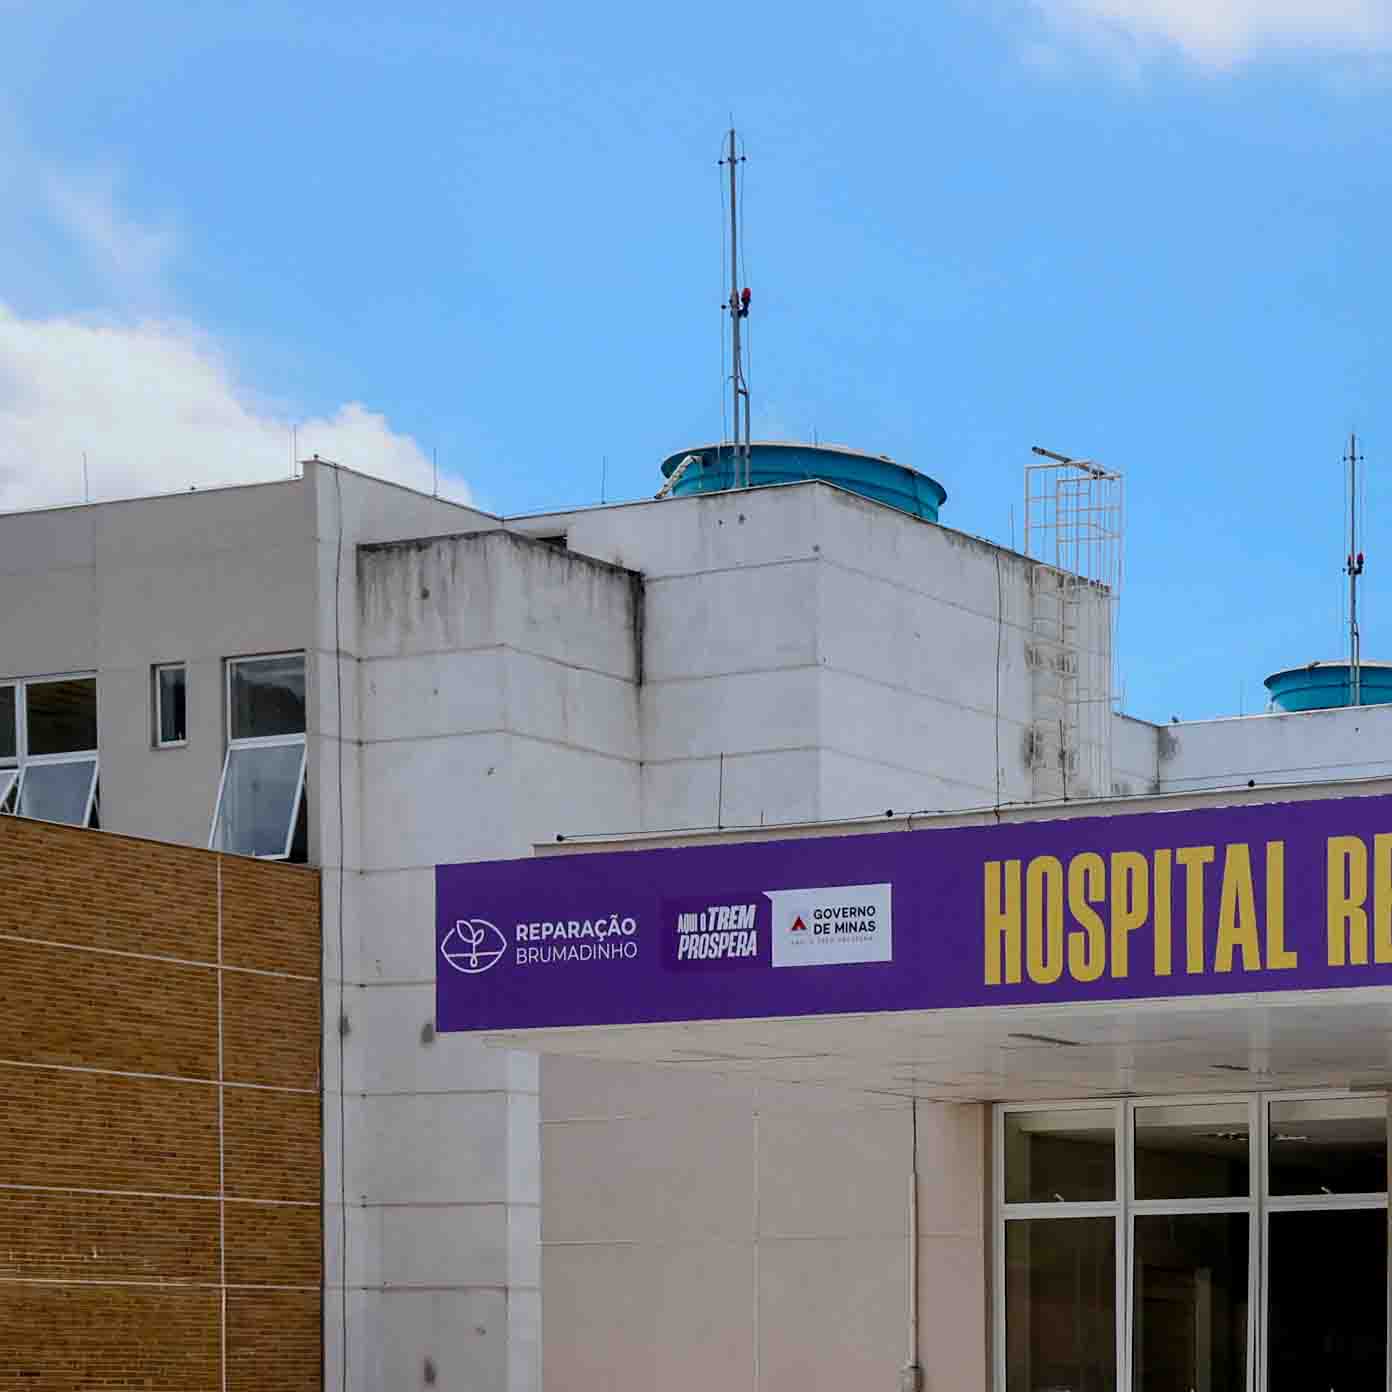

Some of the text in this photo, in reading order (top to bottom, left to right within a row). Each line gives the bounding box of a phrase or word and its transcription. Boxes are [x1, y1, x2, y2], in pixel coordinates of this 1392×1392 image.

[678, 912, 698, 934] AQUI
[708, 904, 756, 931] TREM
[813, 905, 876, 920] GOVERNO
[984, 841, 1298, 985] HOSPITAL
[516, 913, 636, 942] REPARAÇÃO
[813, 920, 876, 935] DE MINAS
[516, 942, 637, 965] BRUMADINHO
[678, 930, 757, 960] PROSPERA
